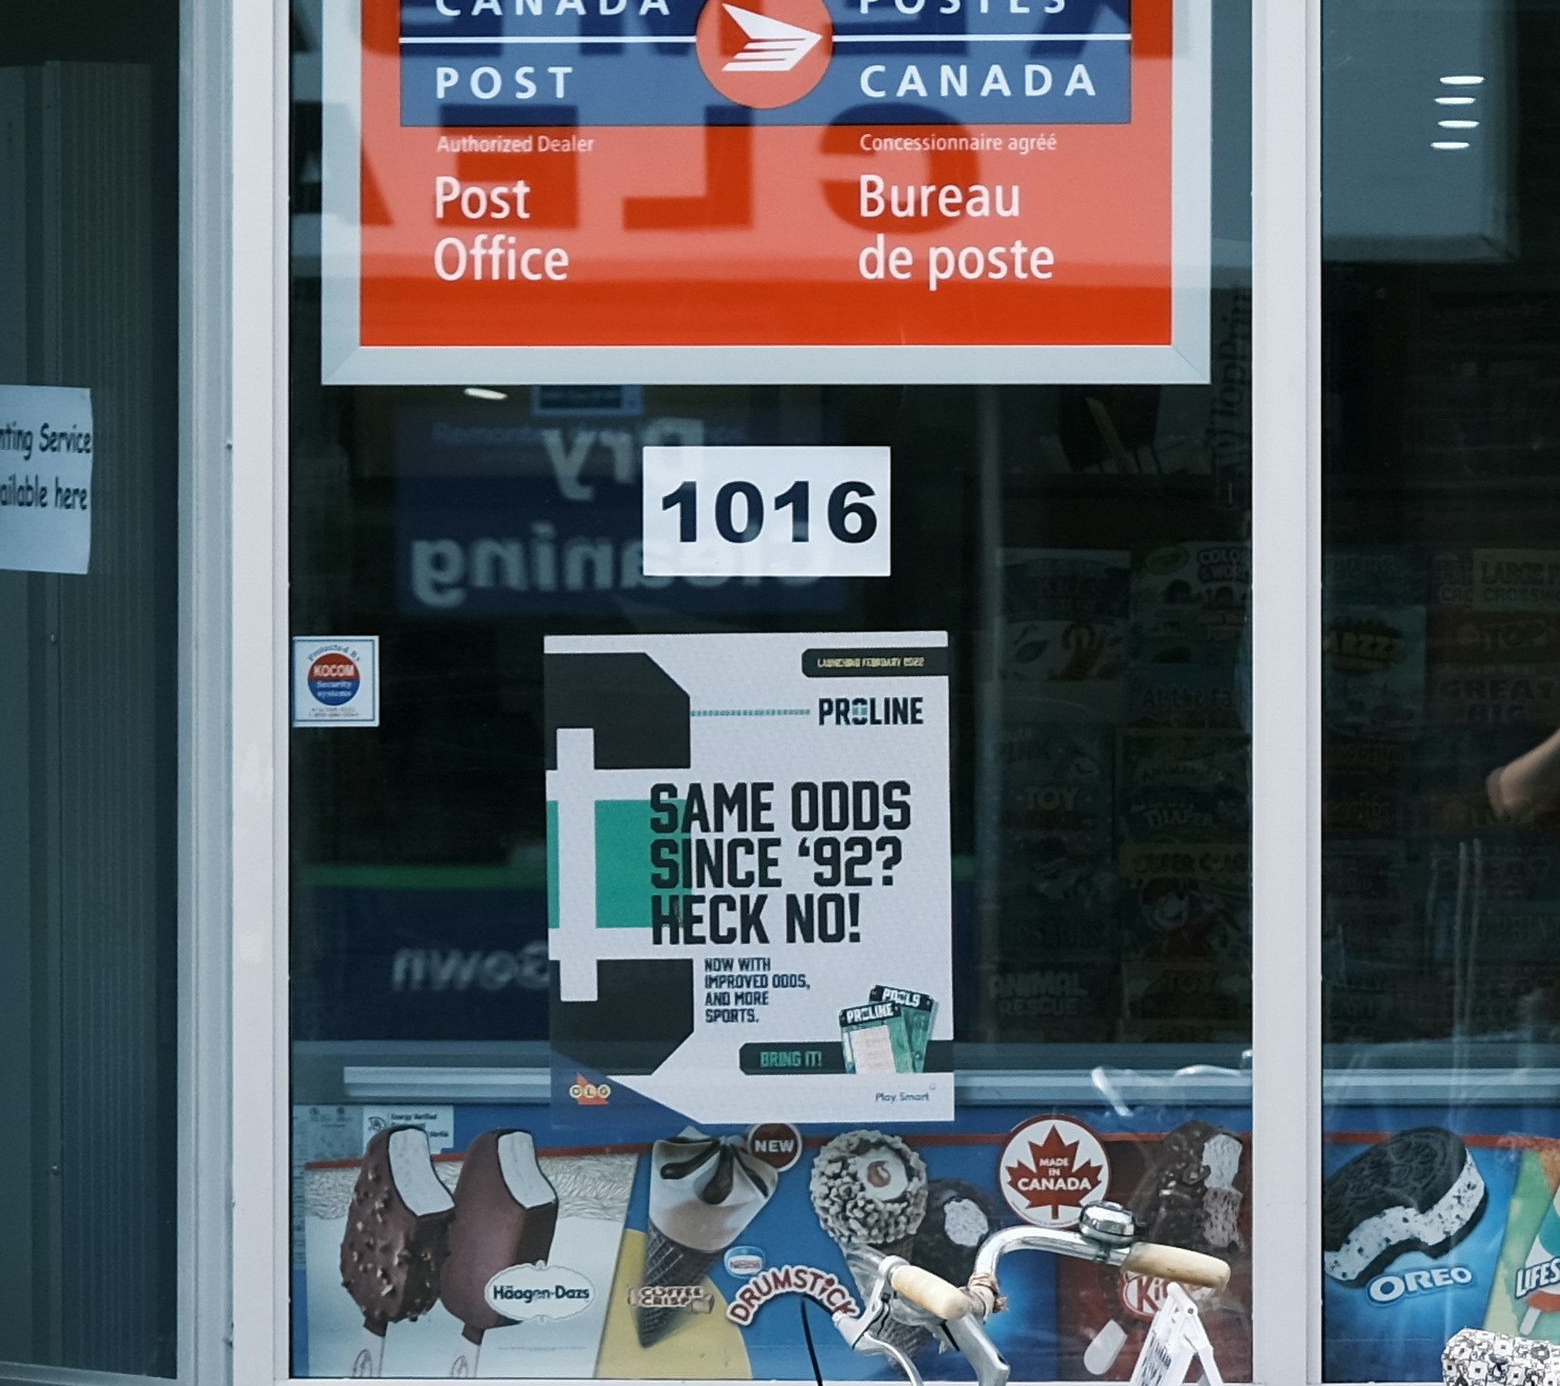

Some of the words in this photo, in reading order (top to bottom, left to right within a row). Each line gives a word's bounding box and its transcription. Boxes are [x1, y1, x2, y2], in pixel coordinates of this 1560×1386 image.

[436, 66, 574, 100] POST
[859, 64, 1097, 98] CANADA
[436, 134, 532, 153] Authorized
[538, 134, 595, 153] Dealer
[859, 133, 1002, 153] Concessionnaire
[1006, 132, 1058, 157] agréé
[434, 175, 531, 221] Post
[858, 173, 1022, 219] Bureau
[433, 234, 571, 282] Office
[858, 232, 913, 281] de
[926, 236, 1056, 290] poste
[39, 422, 92, 455] Service
[54, 475, 88, 511] here
[661, 479, 878, 546] 1016
[313, 664, 355, 677] KOCOM
[818, 696, 924, 726] PROLINE
[650, 781, 774, 834] SAME
[791, 780, 911, 832] ODDS
[650, 837, 782, 889] SINCE
[651, 893, 770, 945] HECK
[786, 893, 861, 944] NO!
[704, 957, 734, 972] NOW
[738, 957, 771, 972] WITH
[704, 974, 768, 989] IMPROVED
[772, 974, 811, 991] ODDS,
[704, 992, 731, 1006] AND
[735, 991, 769, 1006] MORE
[705, 1008, 760, 1024] SPORTS.
[845, 1002, 895, 1024] PROLINE
[760, 1051, 801, 1067] BRING
[805, 1051, 823, 1067] IT!
[875, 1091, 896, 1104] Play
[899, 1091, 930, 1102] Smart
[753, 1138, 794, 1154] NEW
[1039, 1157, 1069, 1167] MADE
[1048, 1168, 1061, 1177] IN
[1017, 1177, 1092, 1191] CANADA
[493, 1283, 590, 1302] Häagen-Dazs
[640, 1286, 702, 1297] COFFEE
[1368, 1266, 1473, 1303] OREO
[641, 1296, 690, 1307] CRISP
